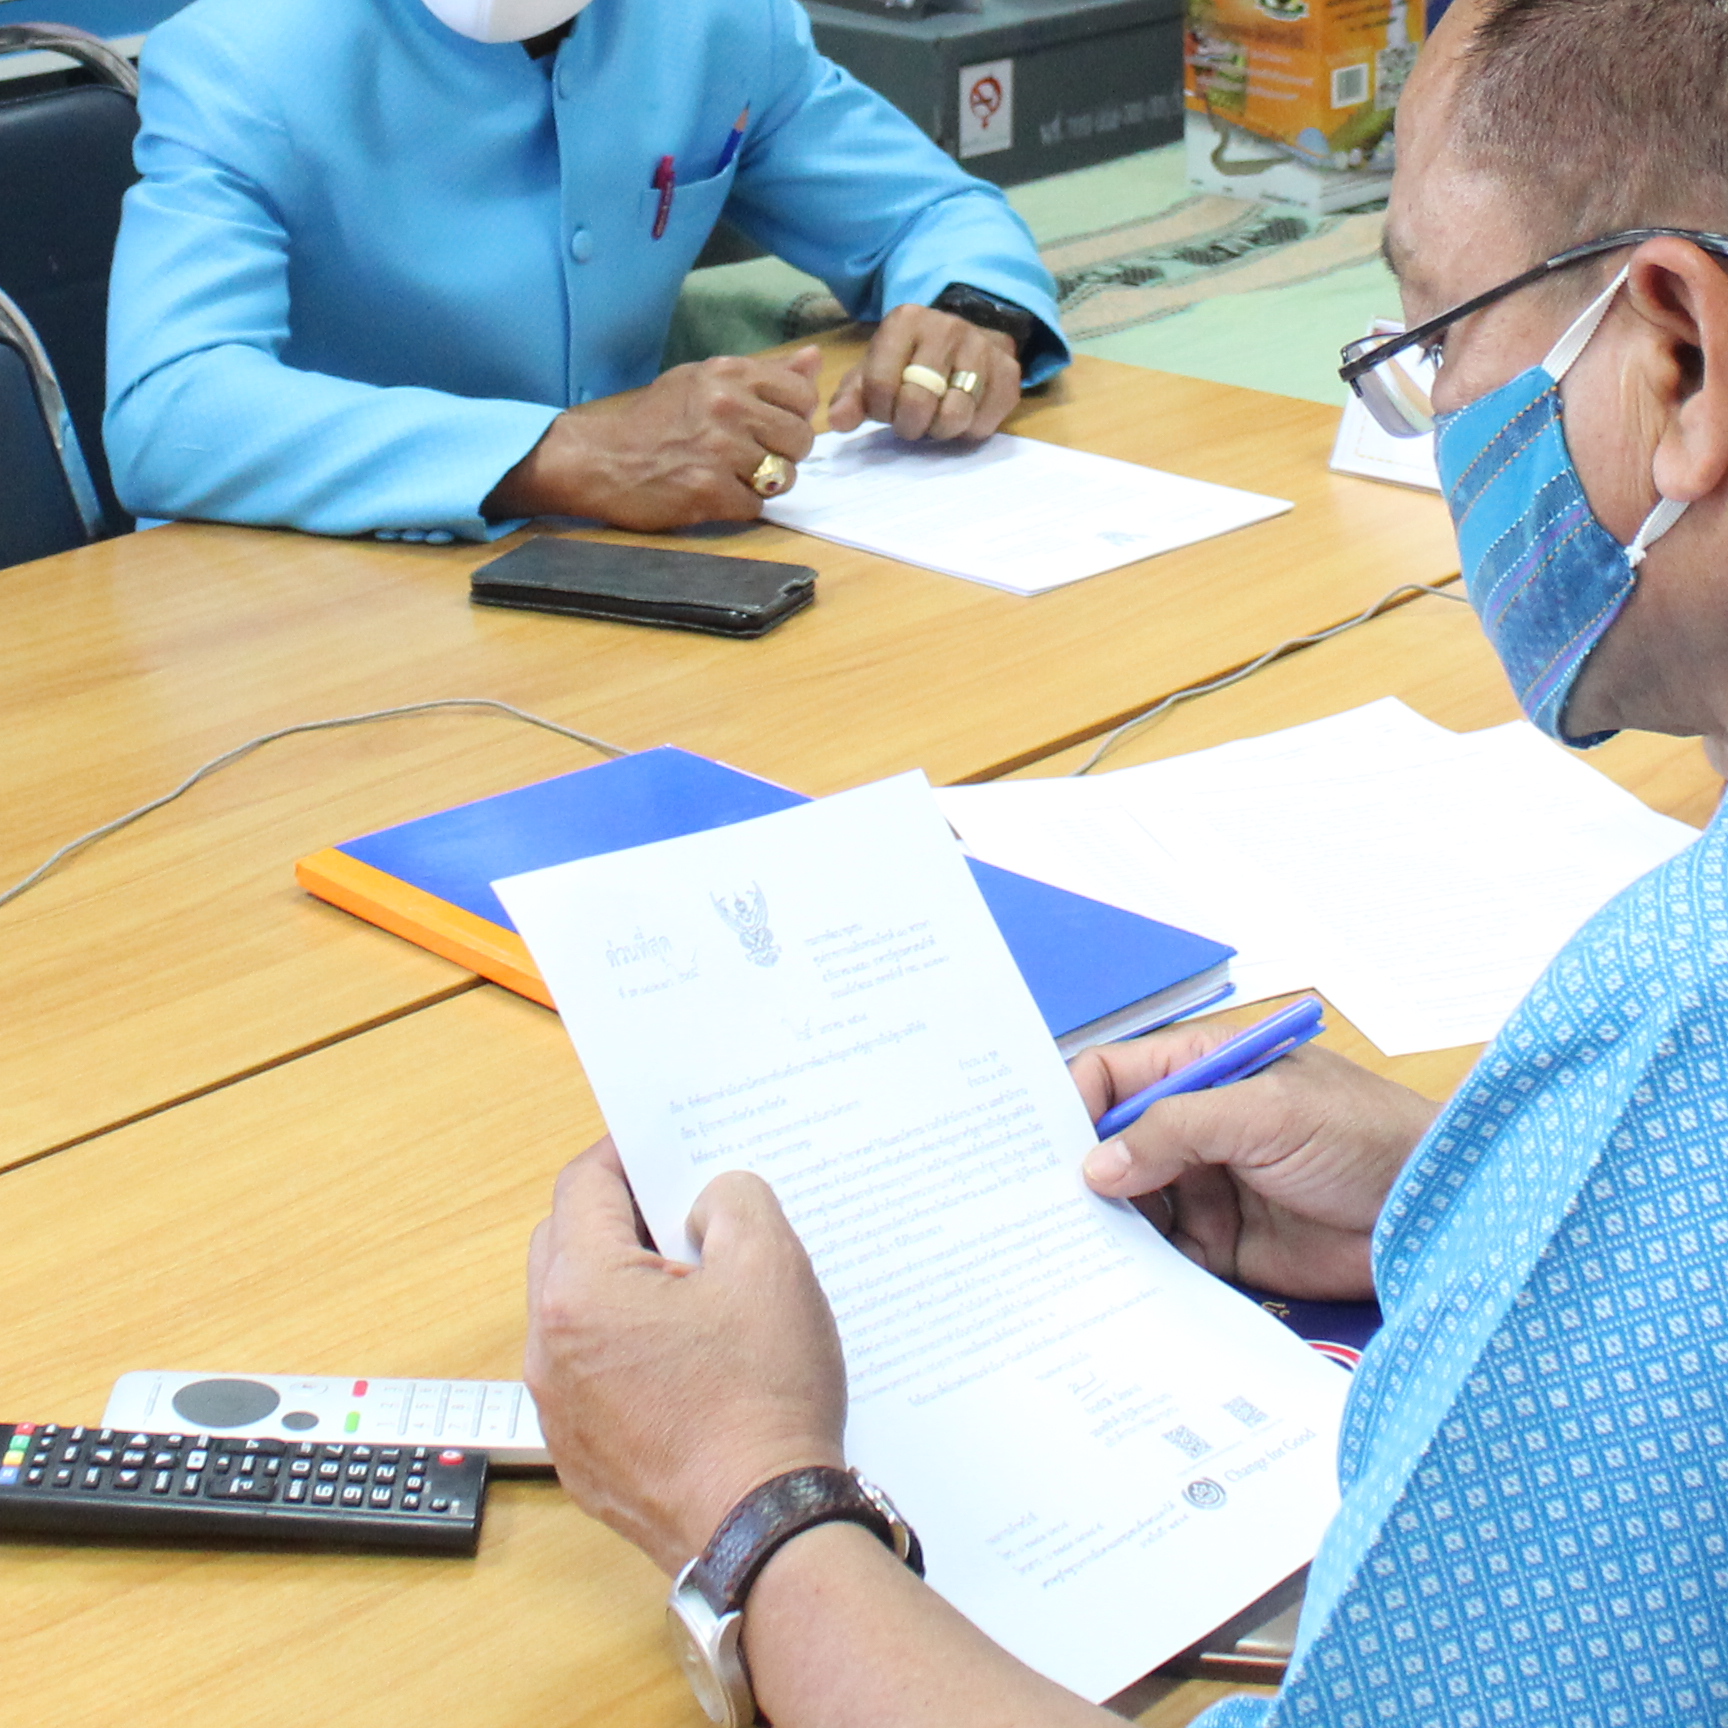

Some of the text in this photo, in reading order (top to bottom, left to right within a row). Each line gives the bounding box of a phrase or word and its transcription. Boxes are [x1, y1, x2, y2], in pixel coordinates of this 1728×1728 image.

[326, 1444, 344, 1455] 7
[353, 1445, 371, 1456] 4
[381, 1448, 399, 1456] 1
[1224, 1427, 1318, 1482] Change for Good
[291, 1459, 311, 1473] 0
[320, 1461, 339, 1475] 8
[348, 1463, 368, 1476] 5
[376, 1464, 396, 1479] 2
[315, 1483, 335, 1499] 9
[343, 1485, 363, 1500] 6
[372, 1486, 392, 1501] 3
